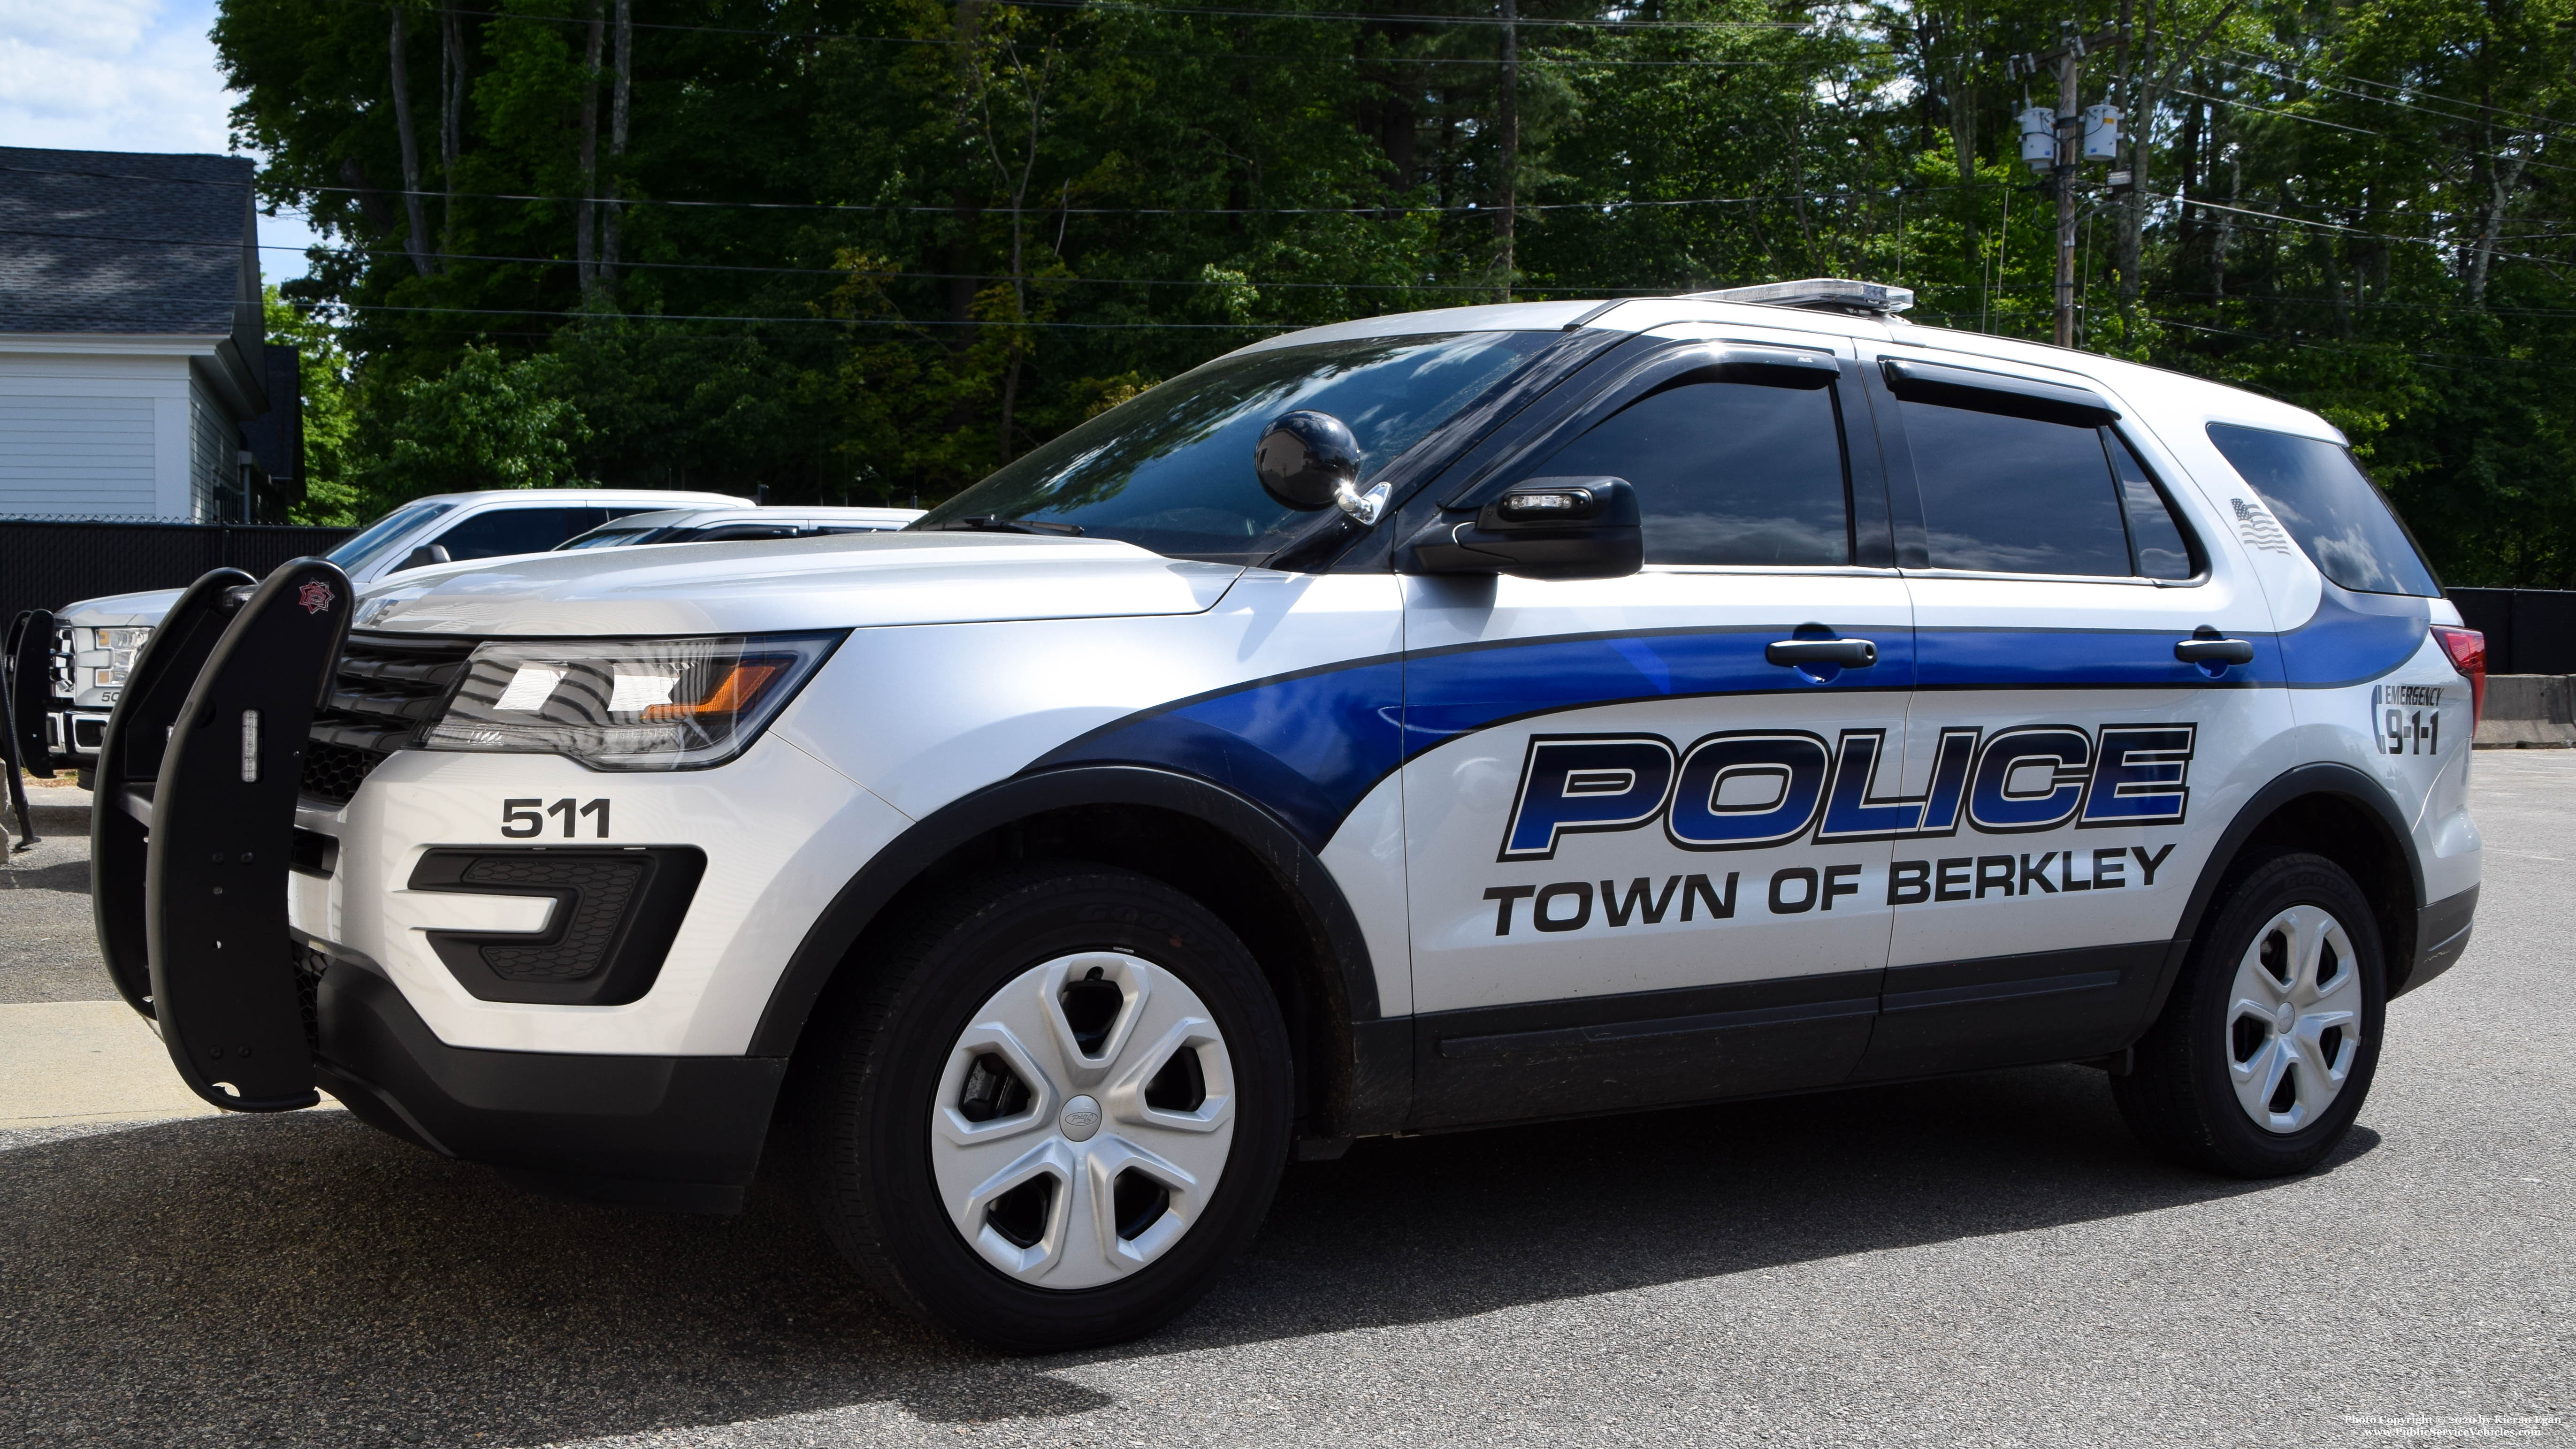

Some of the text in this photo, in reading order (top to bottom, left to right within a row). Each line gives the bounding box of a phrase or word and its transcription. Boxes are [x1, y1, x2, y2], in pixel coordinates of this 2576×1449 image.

[2385, 685, 2444, 706] EMERGENCY
[2386, 709, 2438, 755] 9-1-1
[1497, 723, 2197, 862] POLICE
[501, 798, 610, 838] 511
[1483, 844, 2177, 937] TOWN OF BERKLEY
